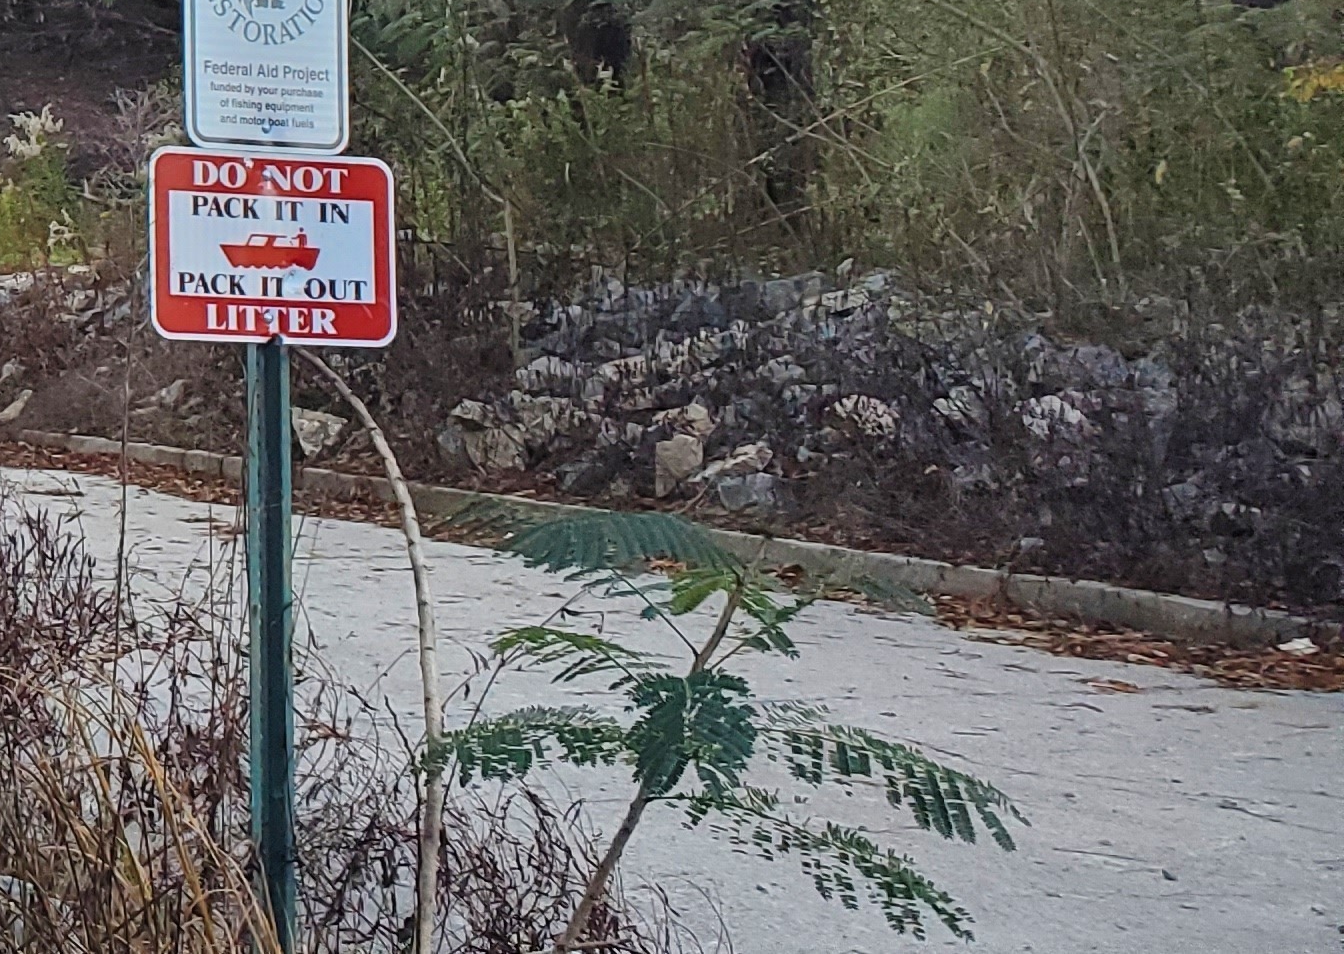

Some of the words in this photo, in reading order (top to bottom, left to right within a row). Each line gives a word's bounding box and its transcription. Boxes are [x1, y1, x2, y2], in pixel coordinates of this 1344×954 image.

[203, 60, 252, 76] Federal
[257, 64, 278, 78] Aid
[283, 65, 330, 83] Project
[210, 81, 242, 93] funded
[244, 84, 255, 96] by
[257, 86, 278, 96] your
[281, 87, 323, 98] purchase
[220, 98, 230, 107] of
[232, 98, 263, 112] fishing
[265, 102, 314, 113] equipment
[220, 114, 238, 124] and
[240, 116, 266, 126] motor
[268, 117, 289, 127] boat
[292, 118, 315, 128] fuels
[192, 160, 247, 189] DO
[260, 165, 348, 194] NOT
[191, 195, 260, 220] PACK
[275, 200, 303, 222] IT
[319, 202, 350, 224] IN
[178, 271, 247, 296] PACK
[261, 276, 285, 297] IT
[305, 277, 368, 301] OUT
[205, 303, 339, 335] LITTER
